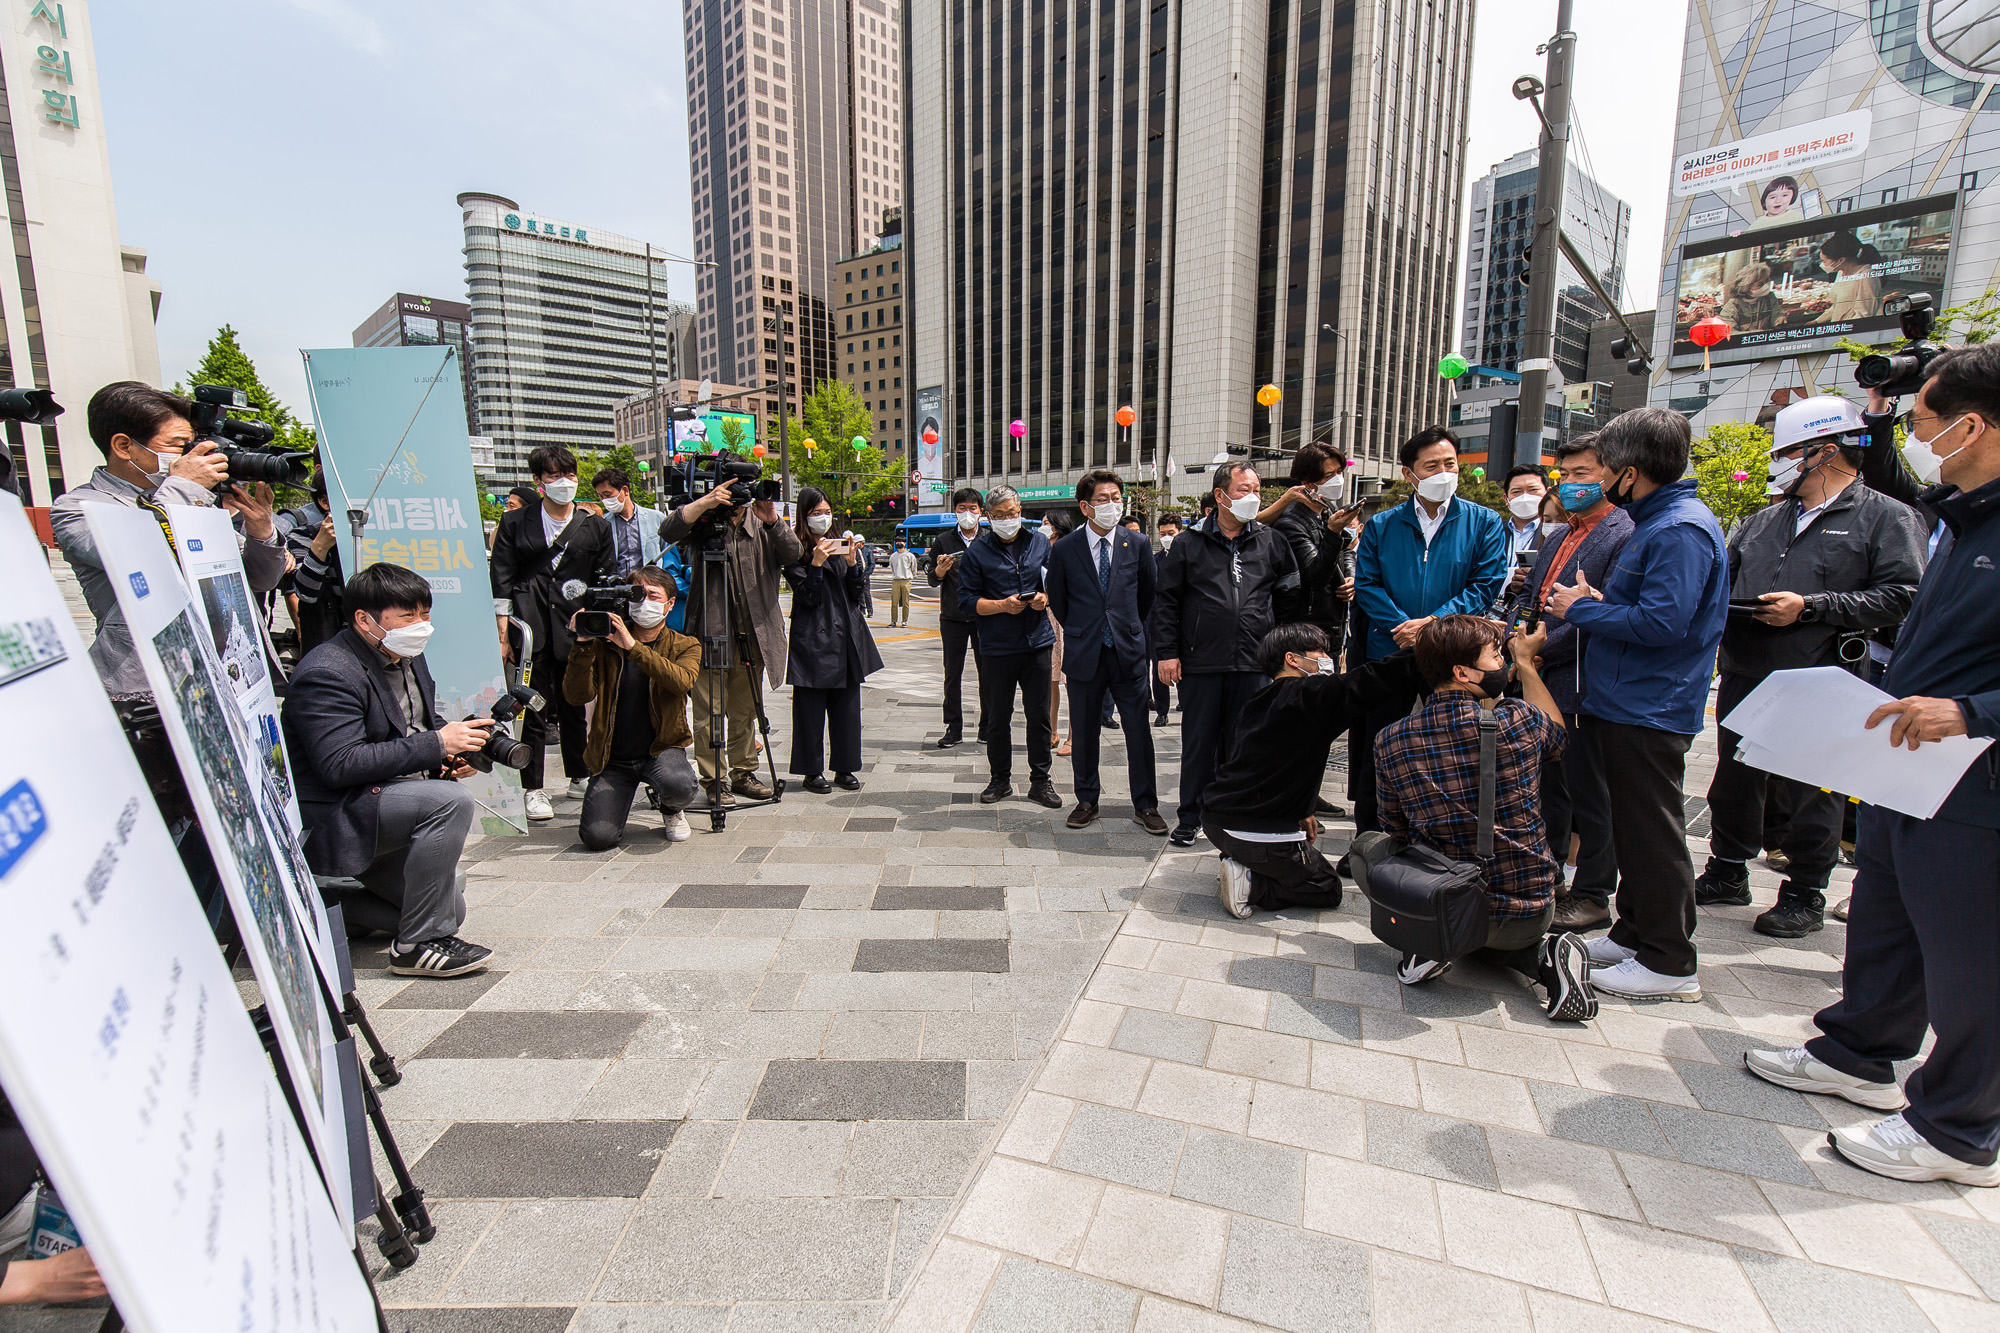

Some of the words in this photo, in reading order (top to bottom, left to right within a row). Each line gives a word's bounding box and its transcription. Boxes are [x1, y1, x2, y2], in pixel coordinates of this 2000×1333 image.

[30, 0, 80, 129] 시의회
[1681, 162, 1727, 182] 여러분의
[1730, 150, 1779, 170] 이야기를
[1783, 131, 1854, 158] 띄워주세요!
[1683, 148, 1739, 170] 실시간으로
[526, 218, 589, 243] 東亞日報
[404, 301, 431, 313] KYOBO
[1741, 333, 1767, 345] 최고의
[1787, 326, 1815, 338] 백신과
[1815, 323, 1854, 335] 함께하는
[1775, 342, 1812, 352] SAMSUNG
[1803, 415, 1842, 429] 수성엔지니어링
